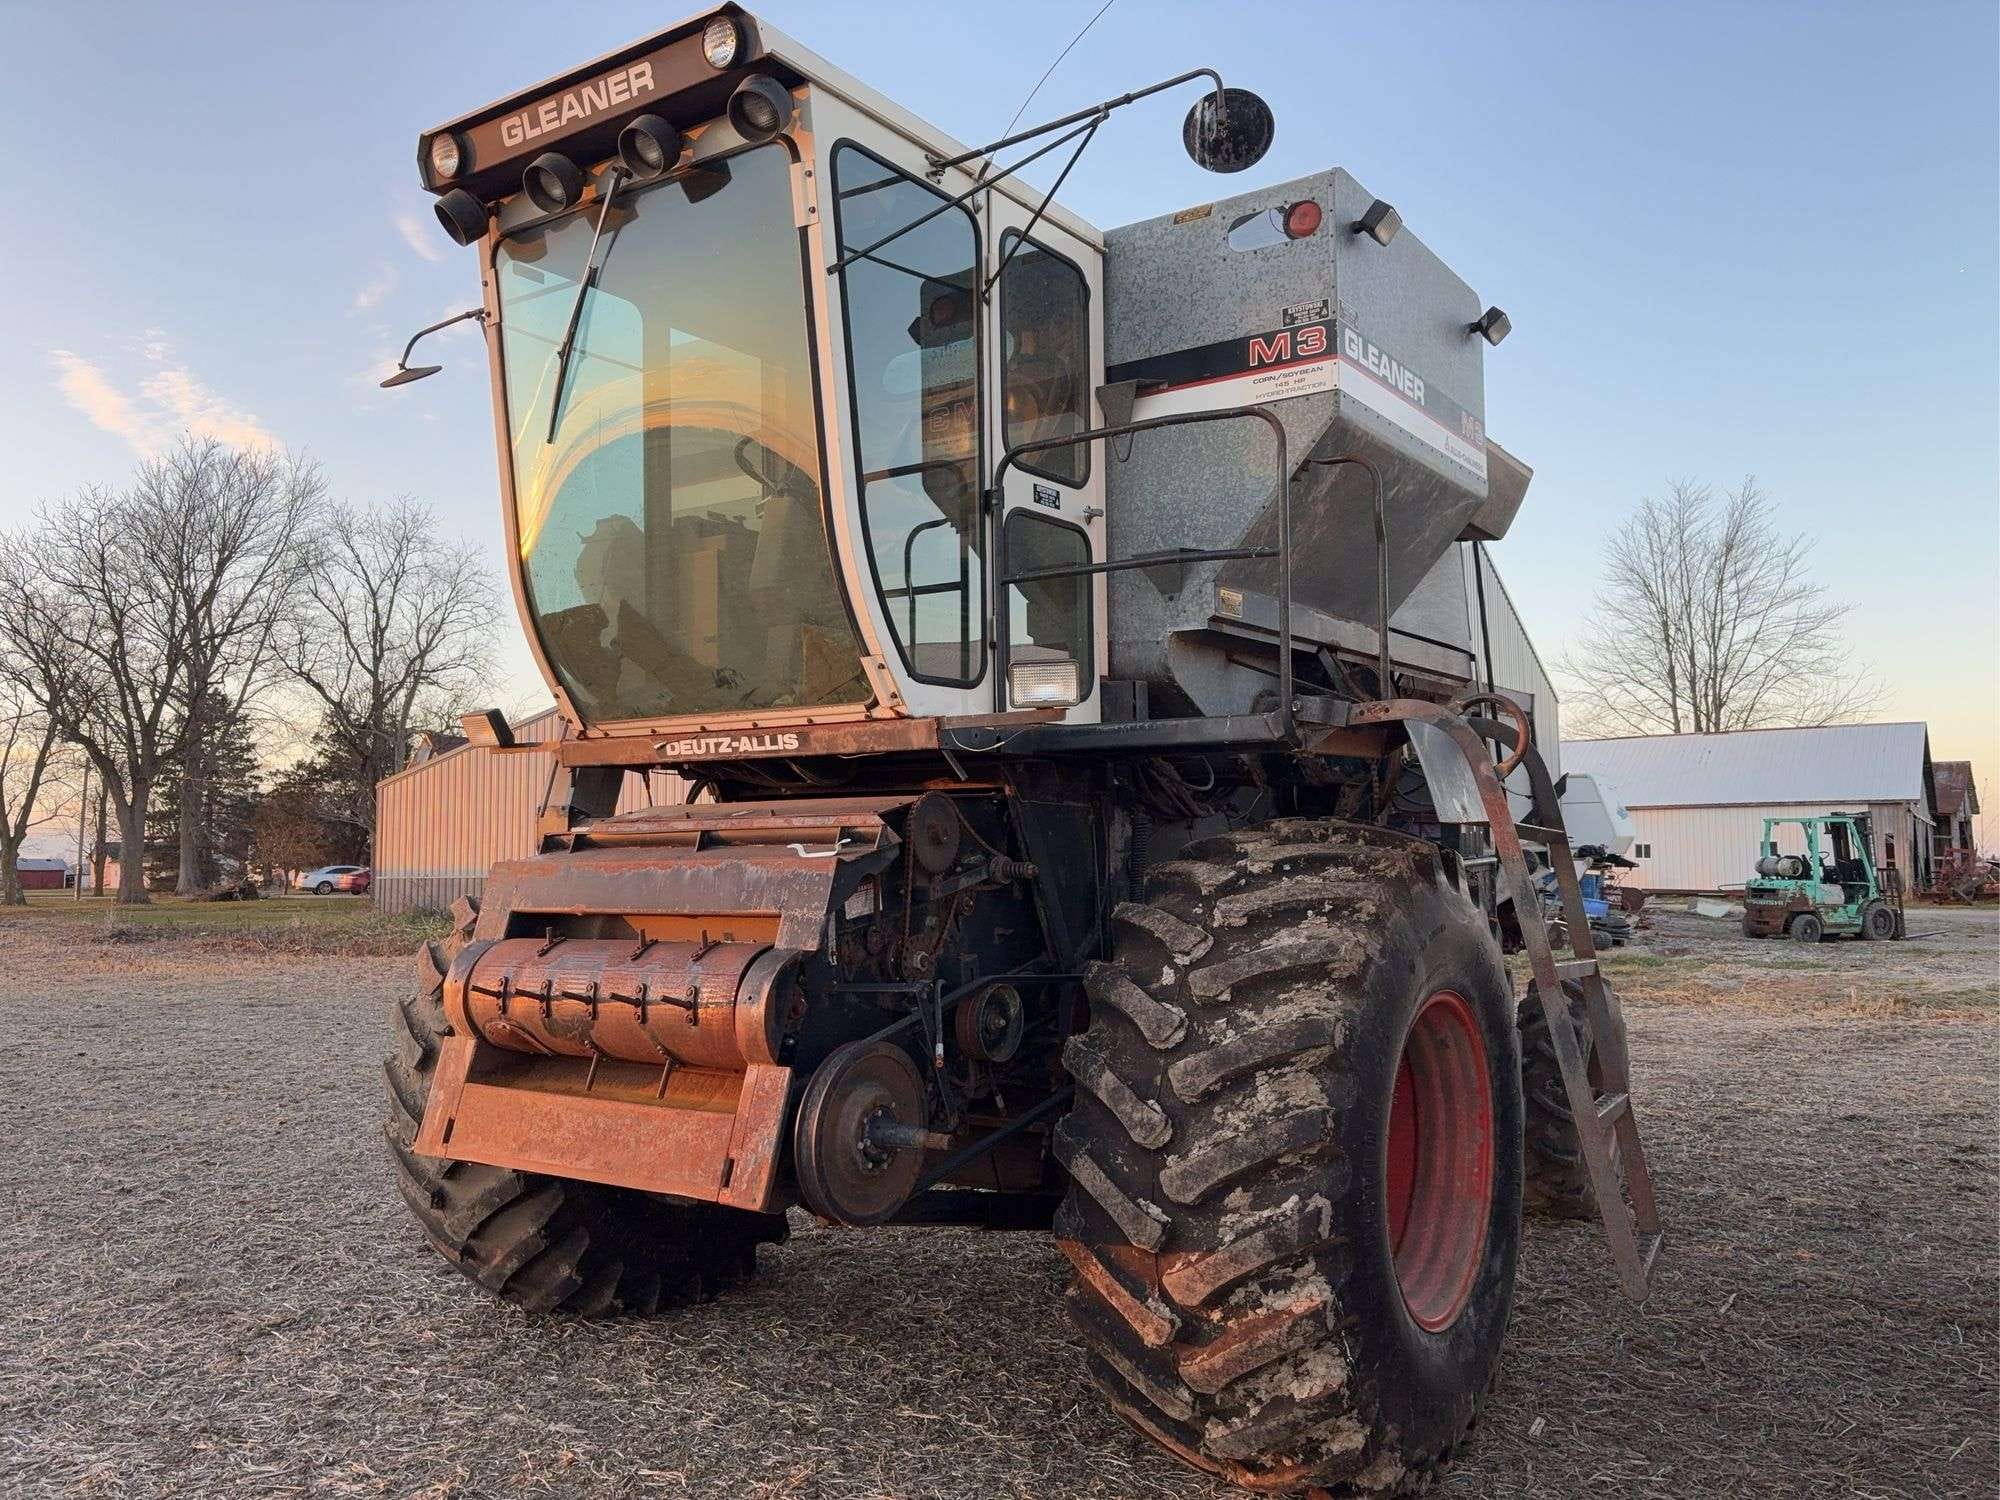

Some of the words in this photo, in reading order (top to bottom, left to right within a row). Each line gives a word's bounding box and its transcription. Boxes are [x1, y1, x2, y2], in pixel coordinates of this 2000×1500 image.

[501, 61, 655, 147] GLEANER
[1249, 326, 1327, 366] M3
[1252, 365, 1324, 384] CORN/SOYBEAN
[1344, 327, 1425, 406] GLEANER
[665, 733, 799, 757] DEUTZ-ALLIS
